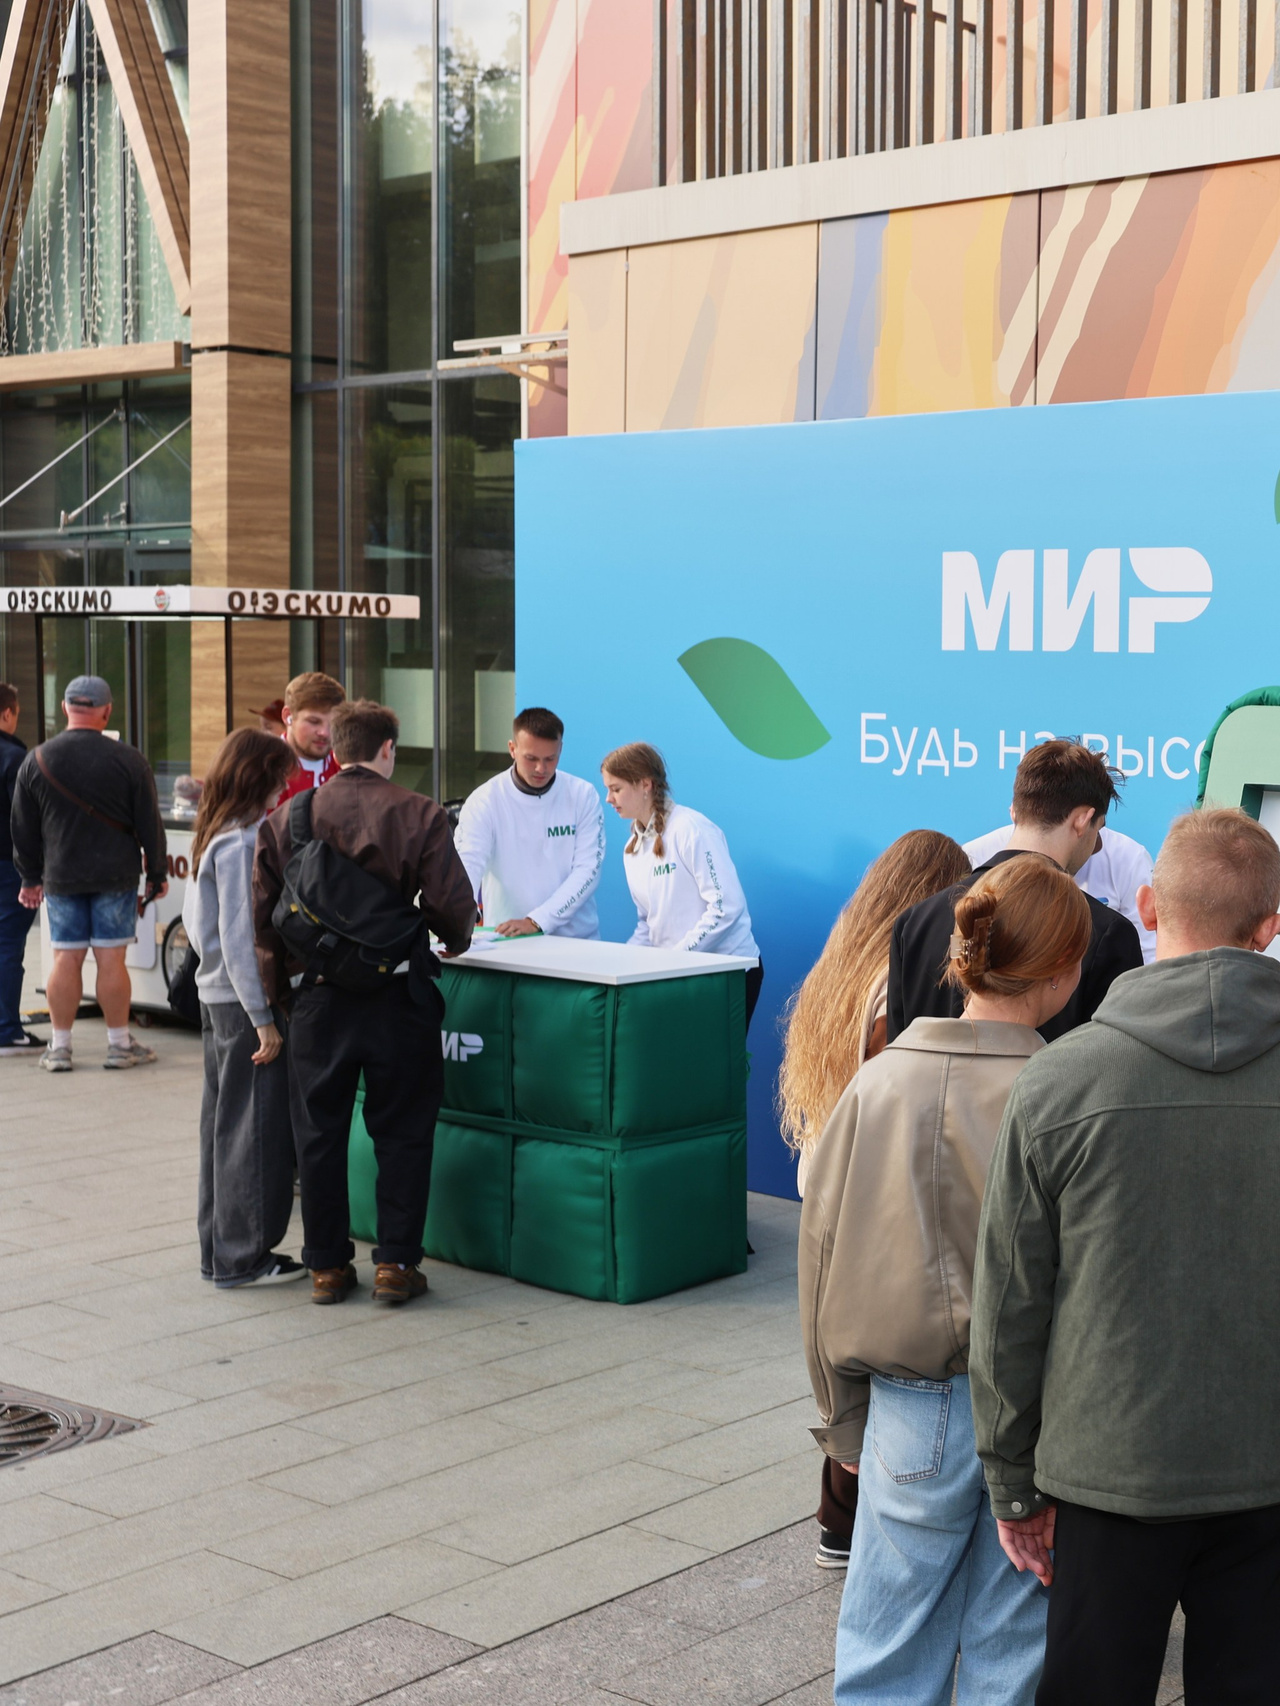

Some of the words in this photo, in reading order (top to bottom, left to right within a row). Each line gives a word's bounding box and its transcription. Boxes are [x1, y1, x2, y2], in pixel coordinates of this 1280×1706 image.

[941, 546, 1213, 654] МИР
[860, 712, 979, 778] Будь
[998, 730, 1057, 770] н
[1081, 733, 1207, 780] выс
[654, 862, 677, 877] МИР
[441, 1029, 484, 1062] ИР
